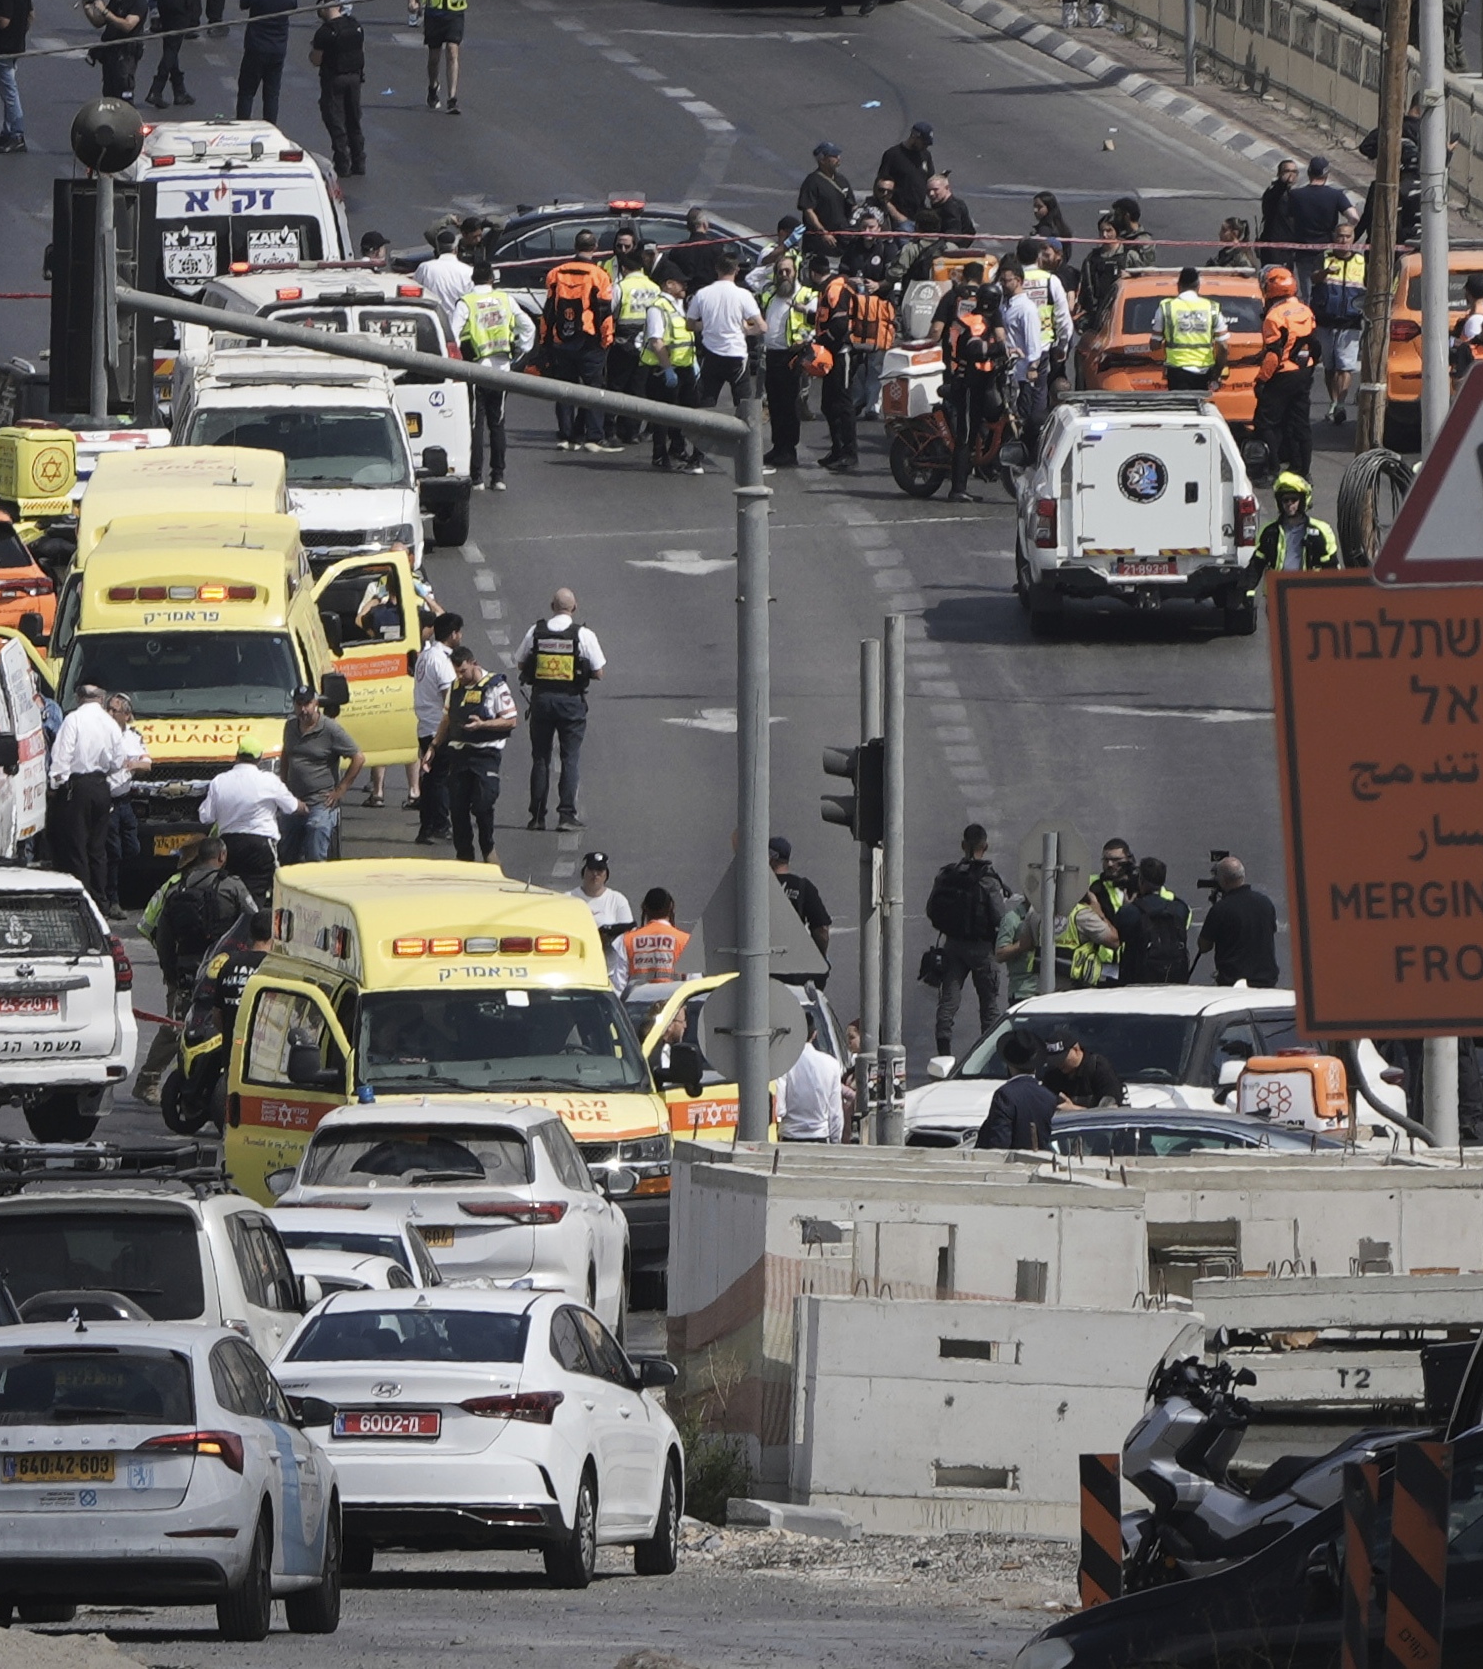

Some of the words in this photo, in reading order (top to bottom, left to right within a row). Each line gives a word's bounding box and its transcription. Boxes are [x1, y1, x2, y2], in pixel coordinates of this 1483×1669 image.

[144, 611, 219, 625] פראמדיק
[140, 733, 241, 746] BULANC
[1349, 750, 1479, 801] تندمج
[635, 935, 674, 950] חובש
[439, 966, 528, 983] פראמדיק
[34, 1038, 82, 1053] משמר
[1337, 1368, 1372, 1389] T2
